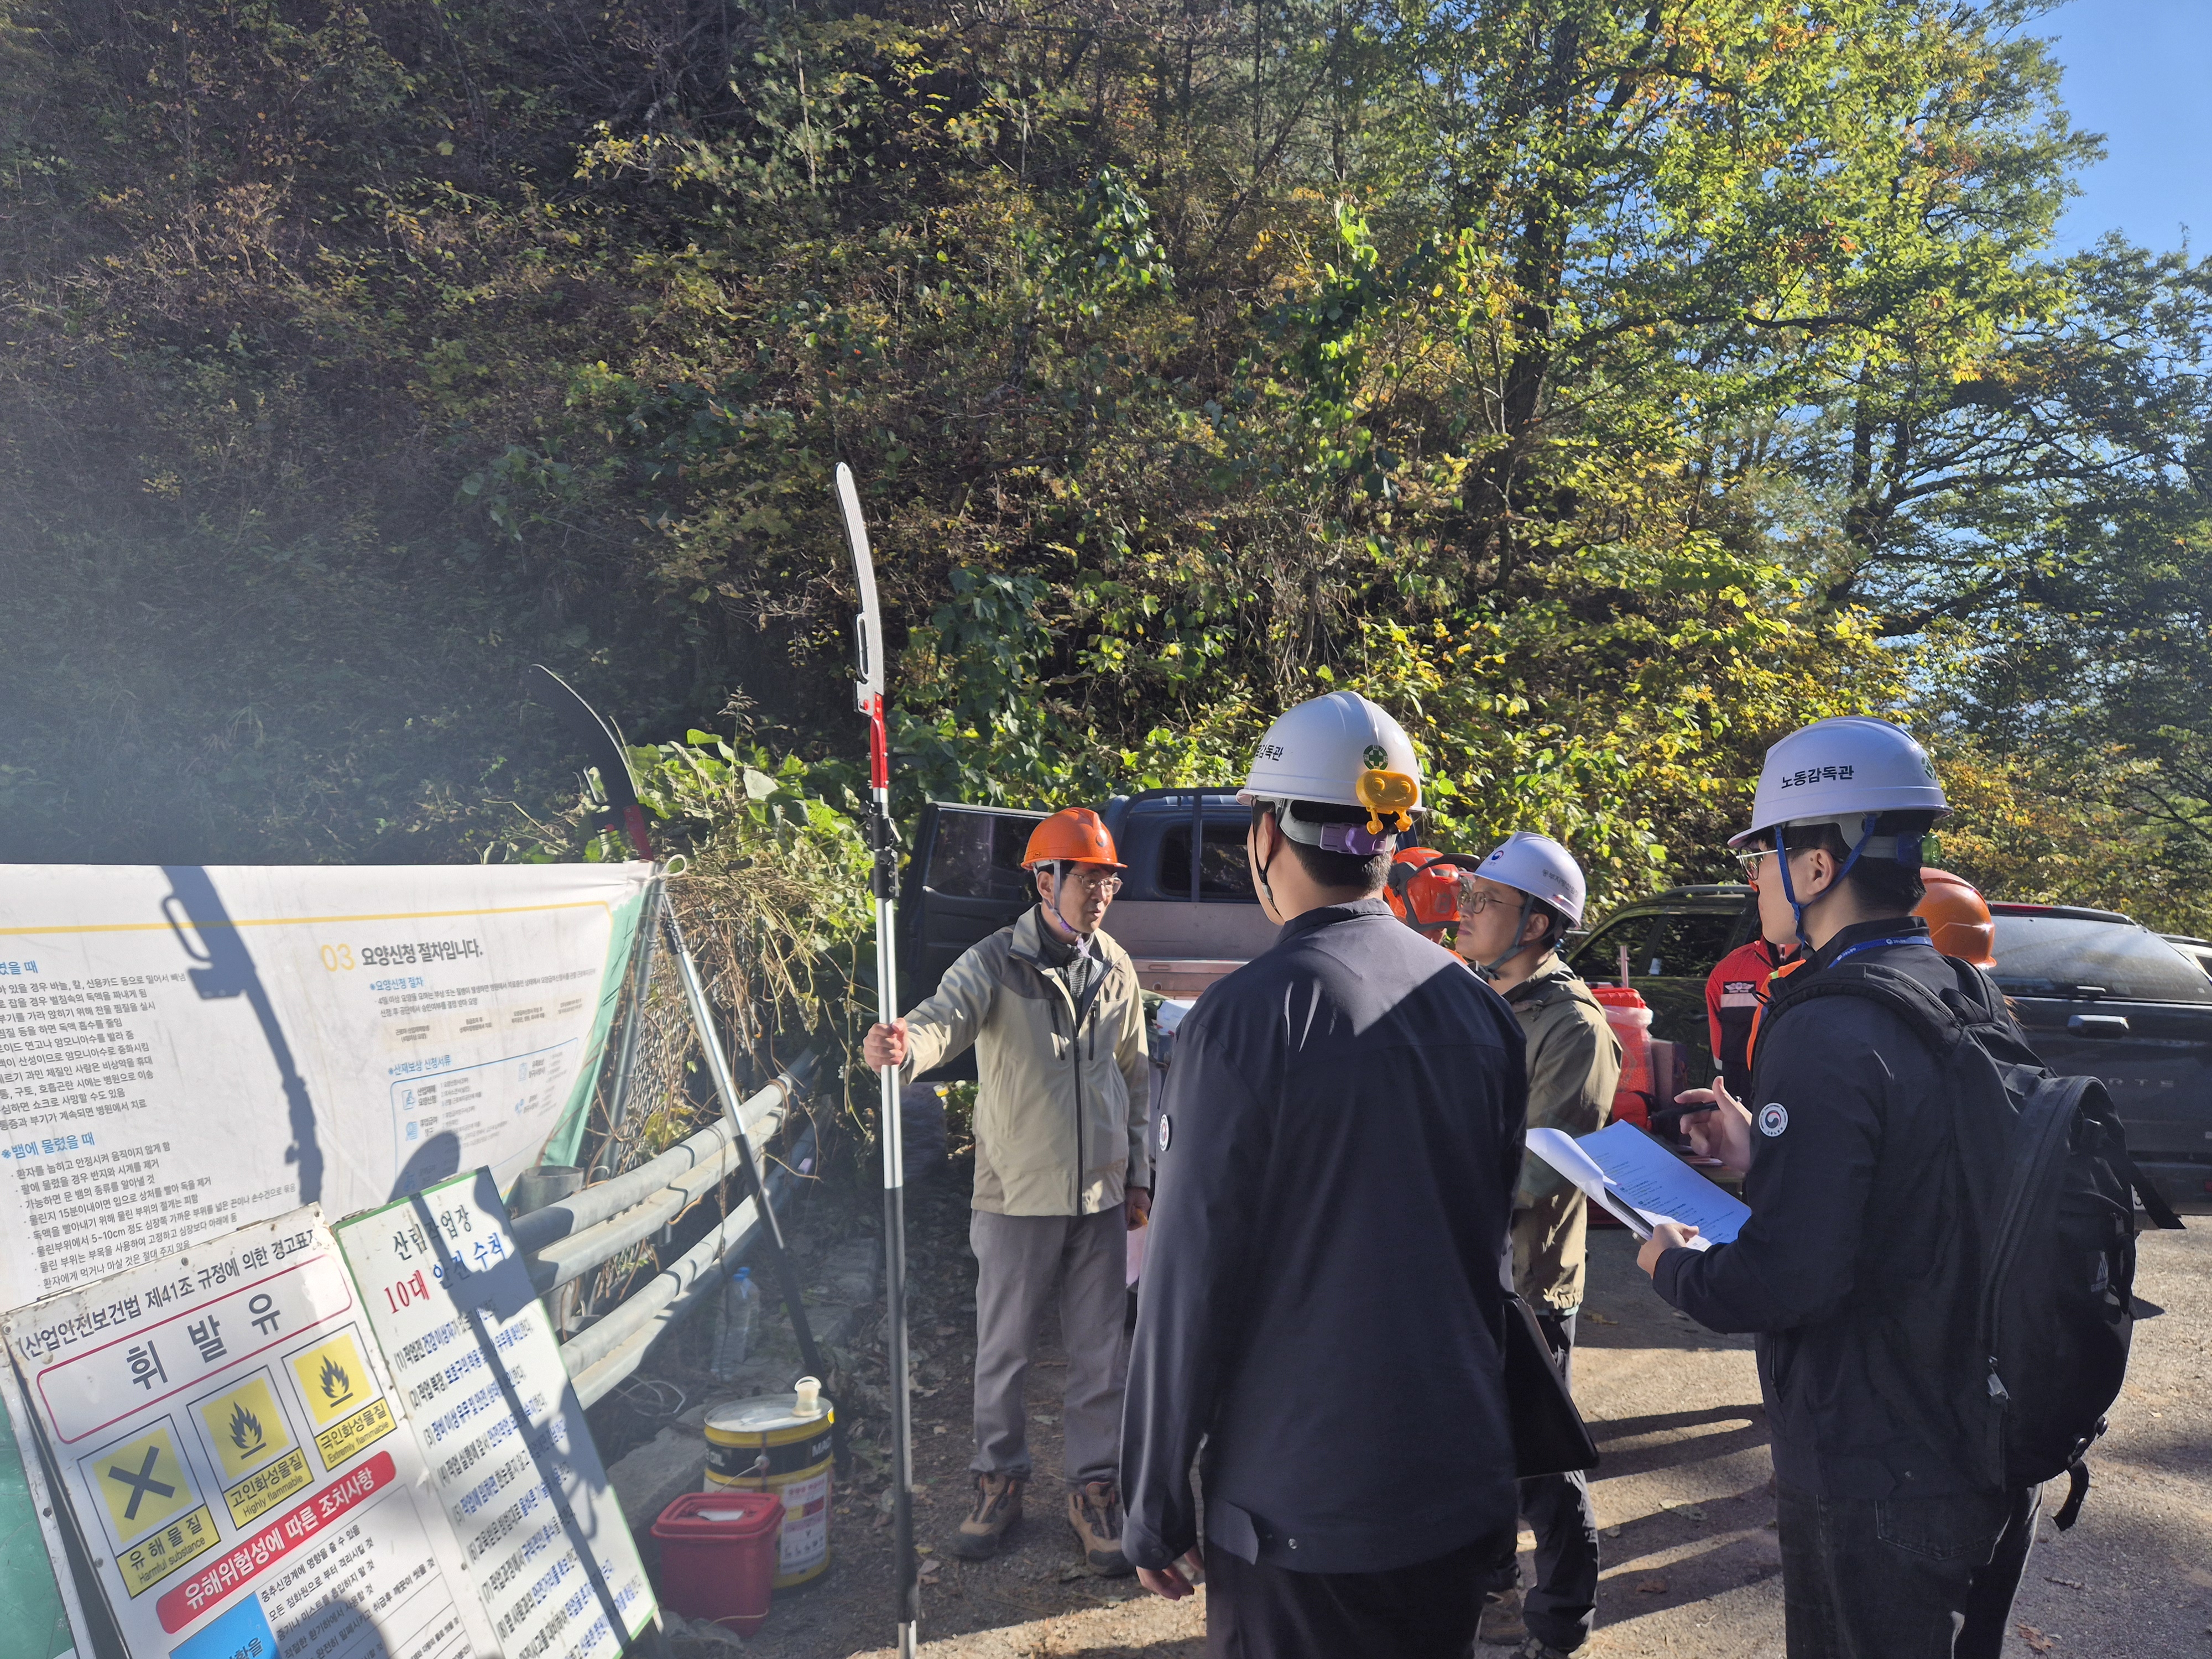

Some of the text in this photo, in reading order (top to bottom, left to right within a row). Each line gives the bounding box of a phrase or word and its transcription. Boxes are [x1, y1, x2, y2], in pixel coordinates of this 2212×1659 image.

[1781, 765, 1854, 789] 노동감독관
[23, 960, 38, 973] 때
[320, 938, 483, 972] 03 요양신청 절차입니다.
[8, 983, 28, 994] 있을
[29, 982, 48, 993] 경우
[49, 981, 71, 991] 바늘,
[72, 980, 85, 990] 칼,
[86, 978, 119, 988] 신용카드
[120, 975, 144, 986] 등으로
[375, 976, 424, 991] 요양신청 절차
[18, 1018, 123, 1037] 등을 하면 독액 흡수를 줄임
[14, 1070, 153, 1097] 구토, 호흡곤란 시에는 병원으로 이송
[393, 1055, 451, 1075] 산재보상 신청서류
[30, 1112, 57, 1125] 부기가
[59, 1107, 95, 1120] 계속되면
[95, 1101, 129, 1115] 병원에서
[131, 1099, 147, 1109] 치료
[11, 1131, 95, 1159] 뱀에 물렸을 때
[15, 1141, 170, 1180] 환자를 눕히고 안정시켜 움직이지 않게 함
[20, 1158, 159, 1195] 팔에 물렸을 경우 반지와 시계를 제거
[29, 1176, 211, 1226] 물린지 15분이내이면 입으로 상처를 빨아 독을 제거
[36, 1235, 89, 1258] 물린부위에서
[91, 1228, 126, 1243] 5~10cm
[127, 1222, 143, 1235] 정도
[145, 1215, 168, 1230] 심장쪽
[169, 1210, 191, 1223] 가까운
[193, 1204, 213, 1217] 부위를
[394, 1205, 471, 1260] 산림작업장
[43, 1270, 78, 1288] 환자에게
[80, 1263, 105, 1276] 먹거나
[107, 1258, 123, 1270] 마실
[125, 1254, 140, 1265] 것은
[142, 1248, 158, 1260] 절대
[17, 1296, 141, 1360] (산업안전보건법
[145, 1276, 195, 1308] 제41조
[197, 1258, 239, 1289] 규정에
[242, 1246, 269, 1269] 의한
[384, 1270, 429, 1313] 10대
[320, 1403, 386, 1449] 극인화성물질
[356, 1421, 389, 1445] flammable
[231, 1453, 302, 1507] 고인화성물질
[242, 1475, 303, 1517] Highly flammable
[186, 1468, 374, 1608] 유해위험성에 따른 조치사항
[138, 1537, 205, 1584] Harmful substance
[261, 1524, 360, 1603] 중추신경계에 영향을 줄 수 있음
[269, 1537, 374, 1622] 모든 점화원으로 부터 격리시킬 것
[275, 1616, 300, 1641] 증기나
[331, 1572, 358, 1599] 흡입하지
[366, 1559, 375, 1571] 것
[373, 1592, 392, 1612] 취급후
[426, 1557, 435, 1568] 것
[284, 1636, 308, 1658] 적절한
[346, 1590, 365, 1609] 사용할
[365, 1583, 374, 1595] 것
